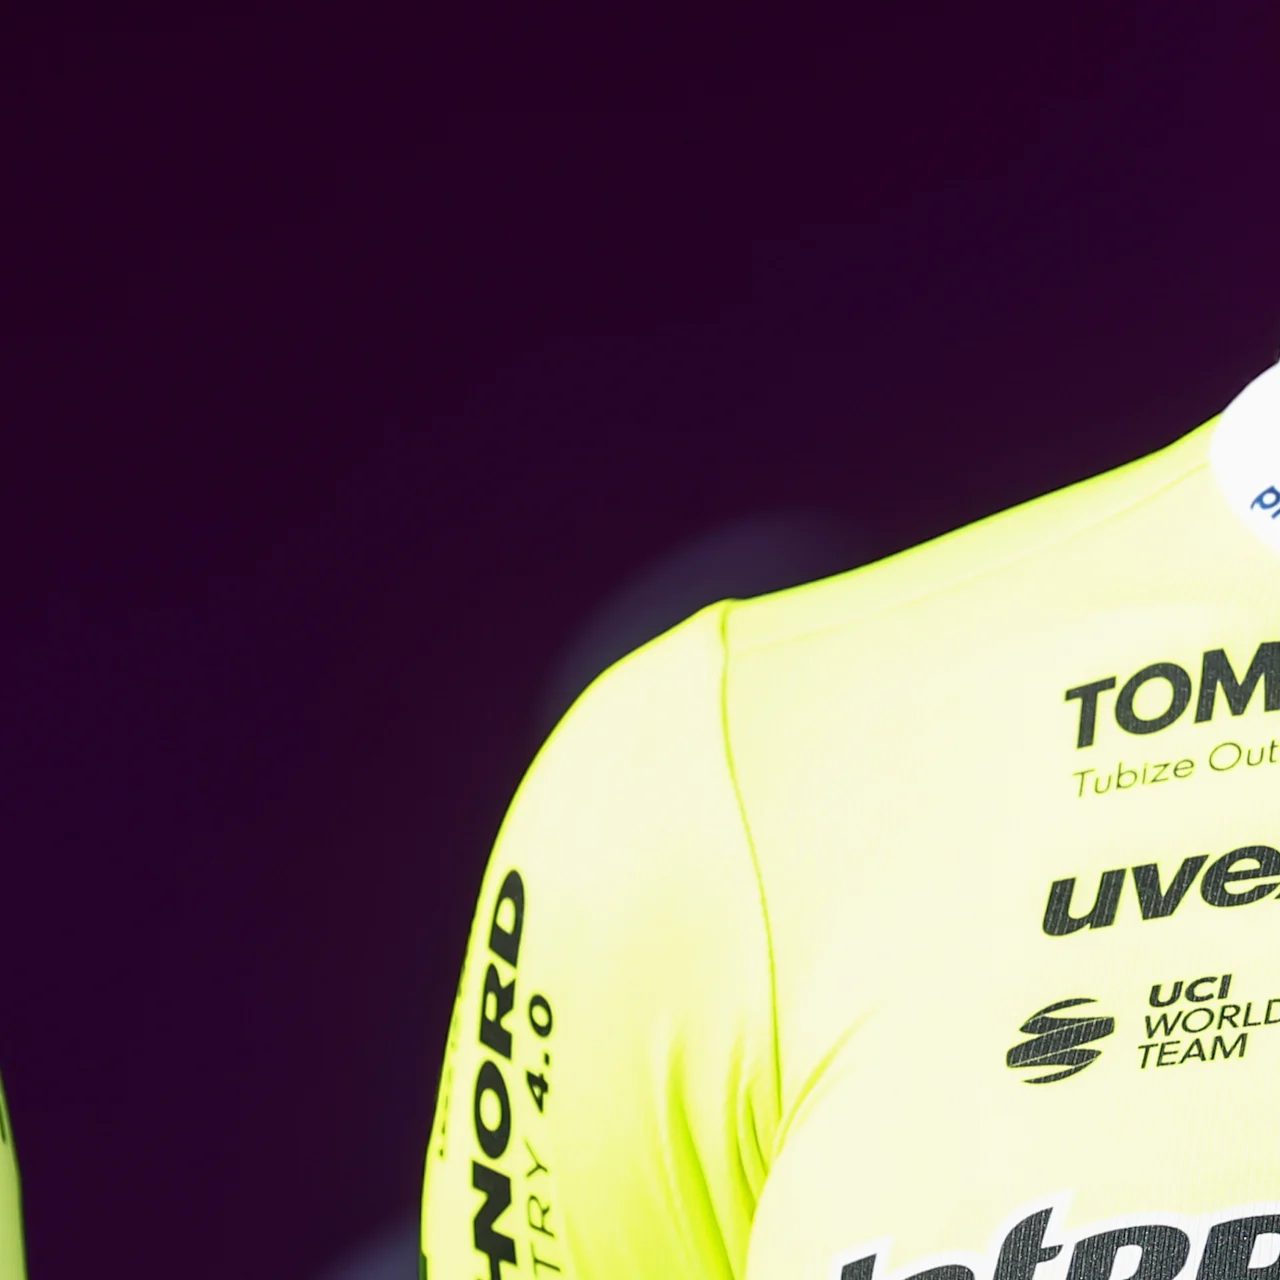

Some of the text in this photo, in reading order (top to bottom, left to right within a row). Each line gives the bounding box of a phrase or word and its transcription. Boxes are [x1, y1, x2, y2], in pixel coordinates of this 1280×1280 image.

[1073, 759, 1195, 797] Tubize
[1149, 974, 1232, 1008] UCI
[526, 993, 554, 1115] 4.0
[1137, 1032, 1249, 1070] TEAM
